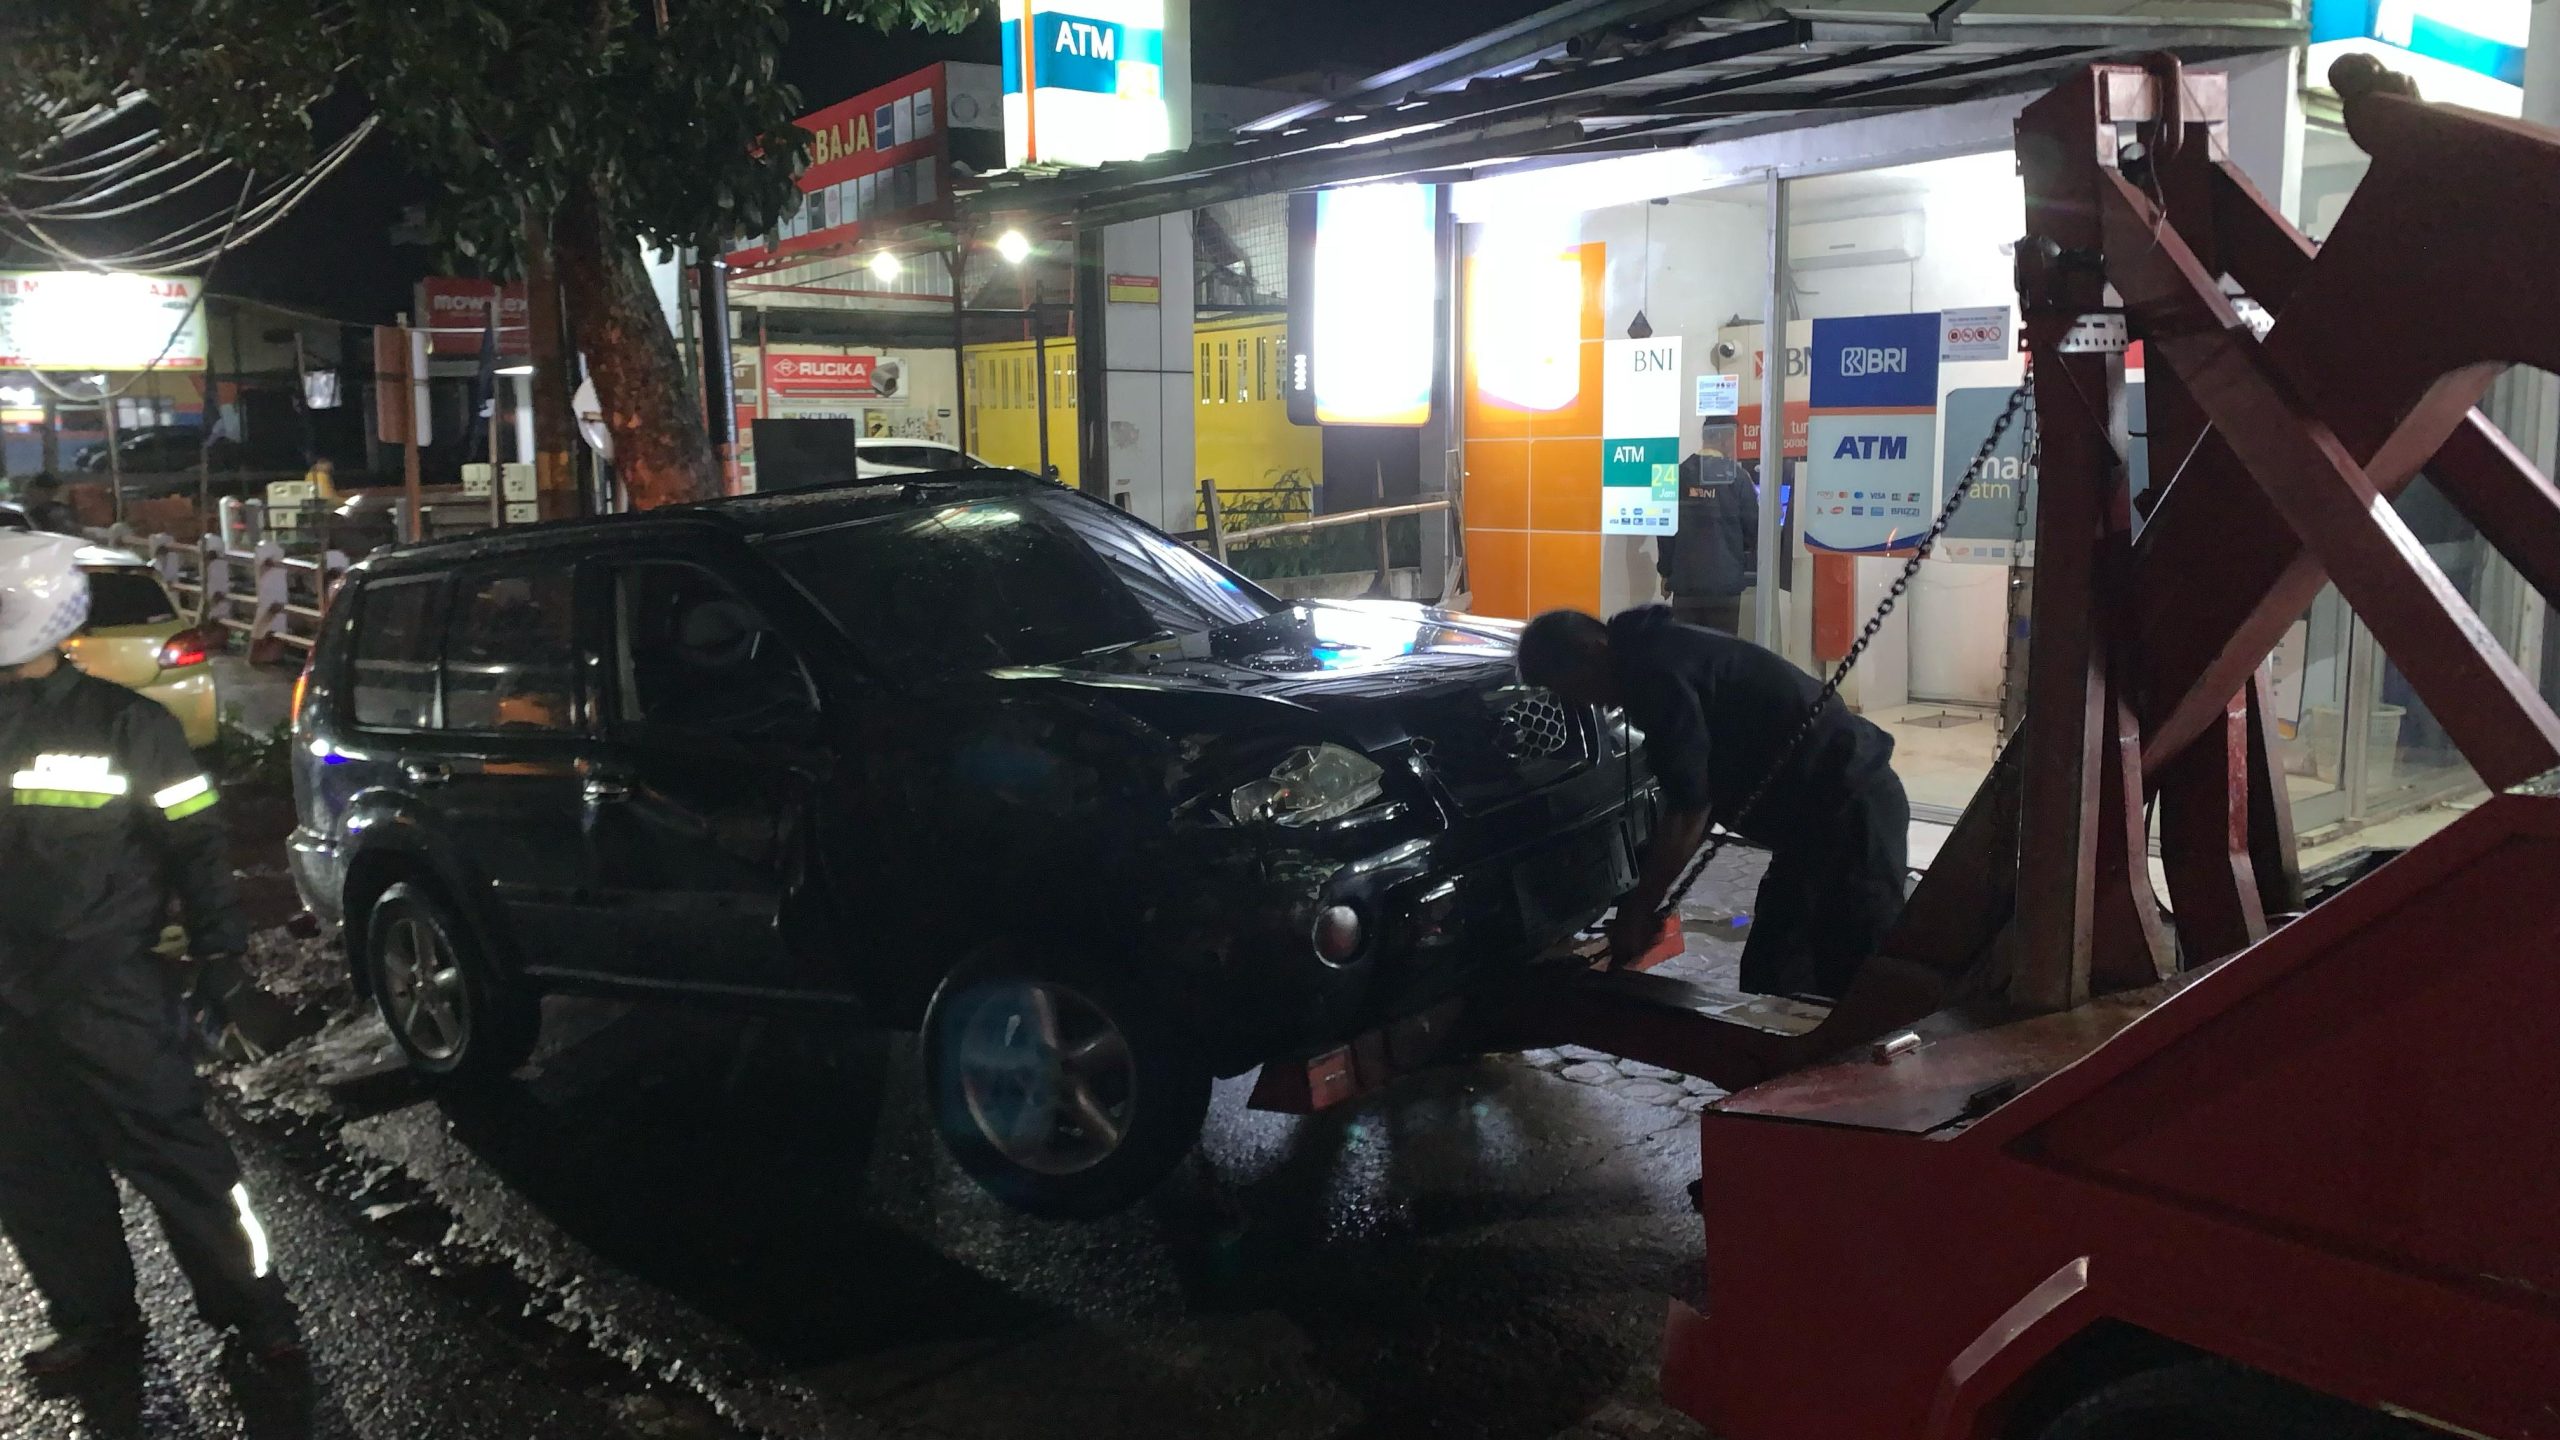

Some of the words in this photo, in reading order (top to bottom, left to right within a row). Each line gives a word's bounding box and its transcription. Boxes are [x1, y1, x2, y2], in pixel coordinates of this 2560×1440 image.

[1055, 20, 1115, 61] ATM
[815, 114, 870, 165] BAJA
[799, 361, 866, 376] RUCIKA
[1634, 348, 1673, 372] BNI
[1867, 347, 1907, 374] BRI
[1613, 445, 1645, 463] ATM
[1833, 436, 1908, 460] ATM
[1652, 464, 1676, 487] 24
[1659, 487, 1676, 498] Jam
[1870, 491, 1886, 500] VISA
[1969, 482, 2011, 499] atm
